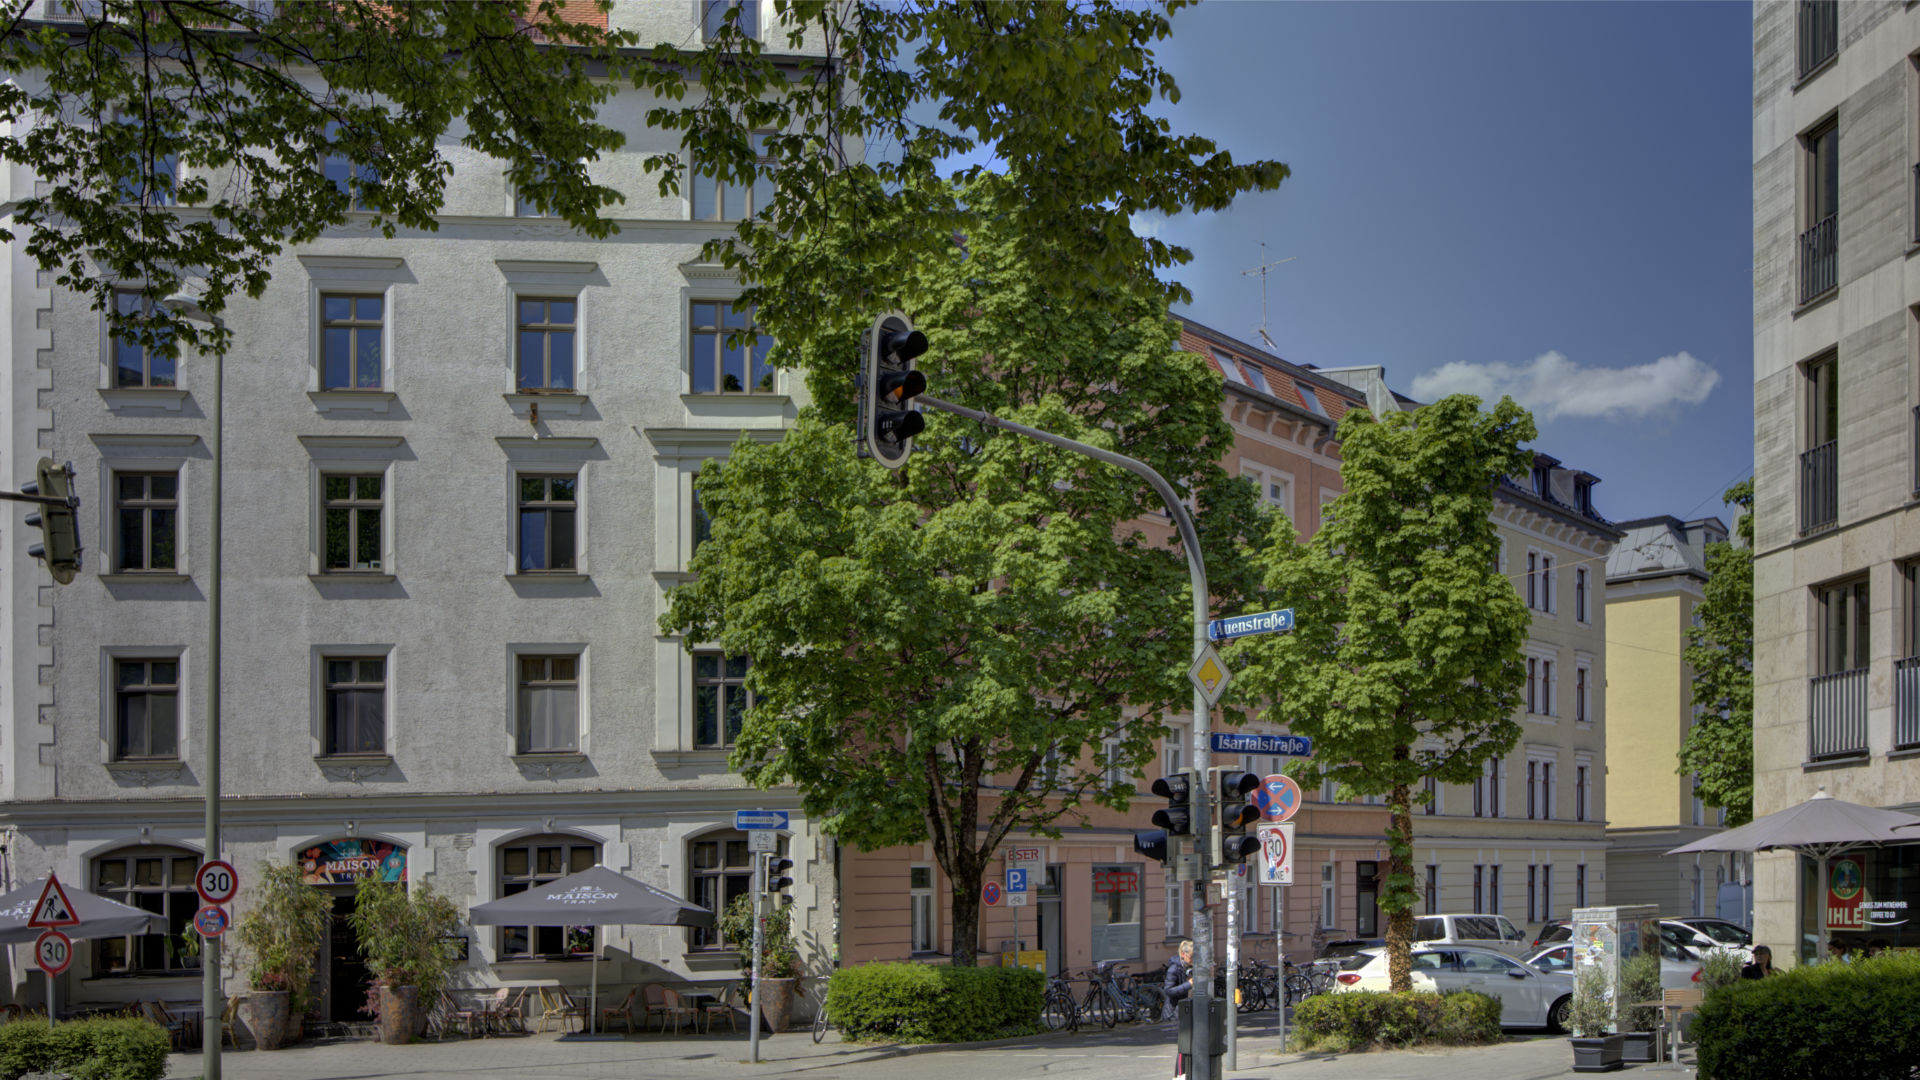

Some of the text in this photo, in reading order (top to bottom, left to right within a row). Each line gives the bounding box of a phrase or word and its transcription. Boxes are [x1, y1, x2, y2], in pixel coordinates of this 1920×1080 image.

[1215, 613, 1286, 636] Auenstraße
[1218, 735, 1304, 754] Isartalstraße
[1008, 848, 1039, 861] ESER
[1268, 839, 1281, 857] 30
[325, 860, 380, 871] MAISON
[205, 873, 229, 892] 30
[1009, 871, 1021, 890] P
[1095, 872, 1138, 893] ESER
[547, 892, 619, 900] MAISON
[1828, 907, 1862, 925] IHLE
[43, 942, 65, 962] 30
